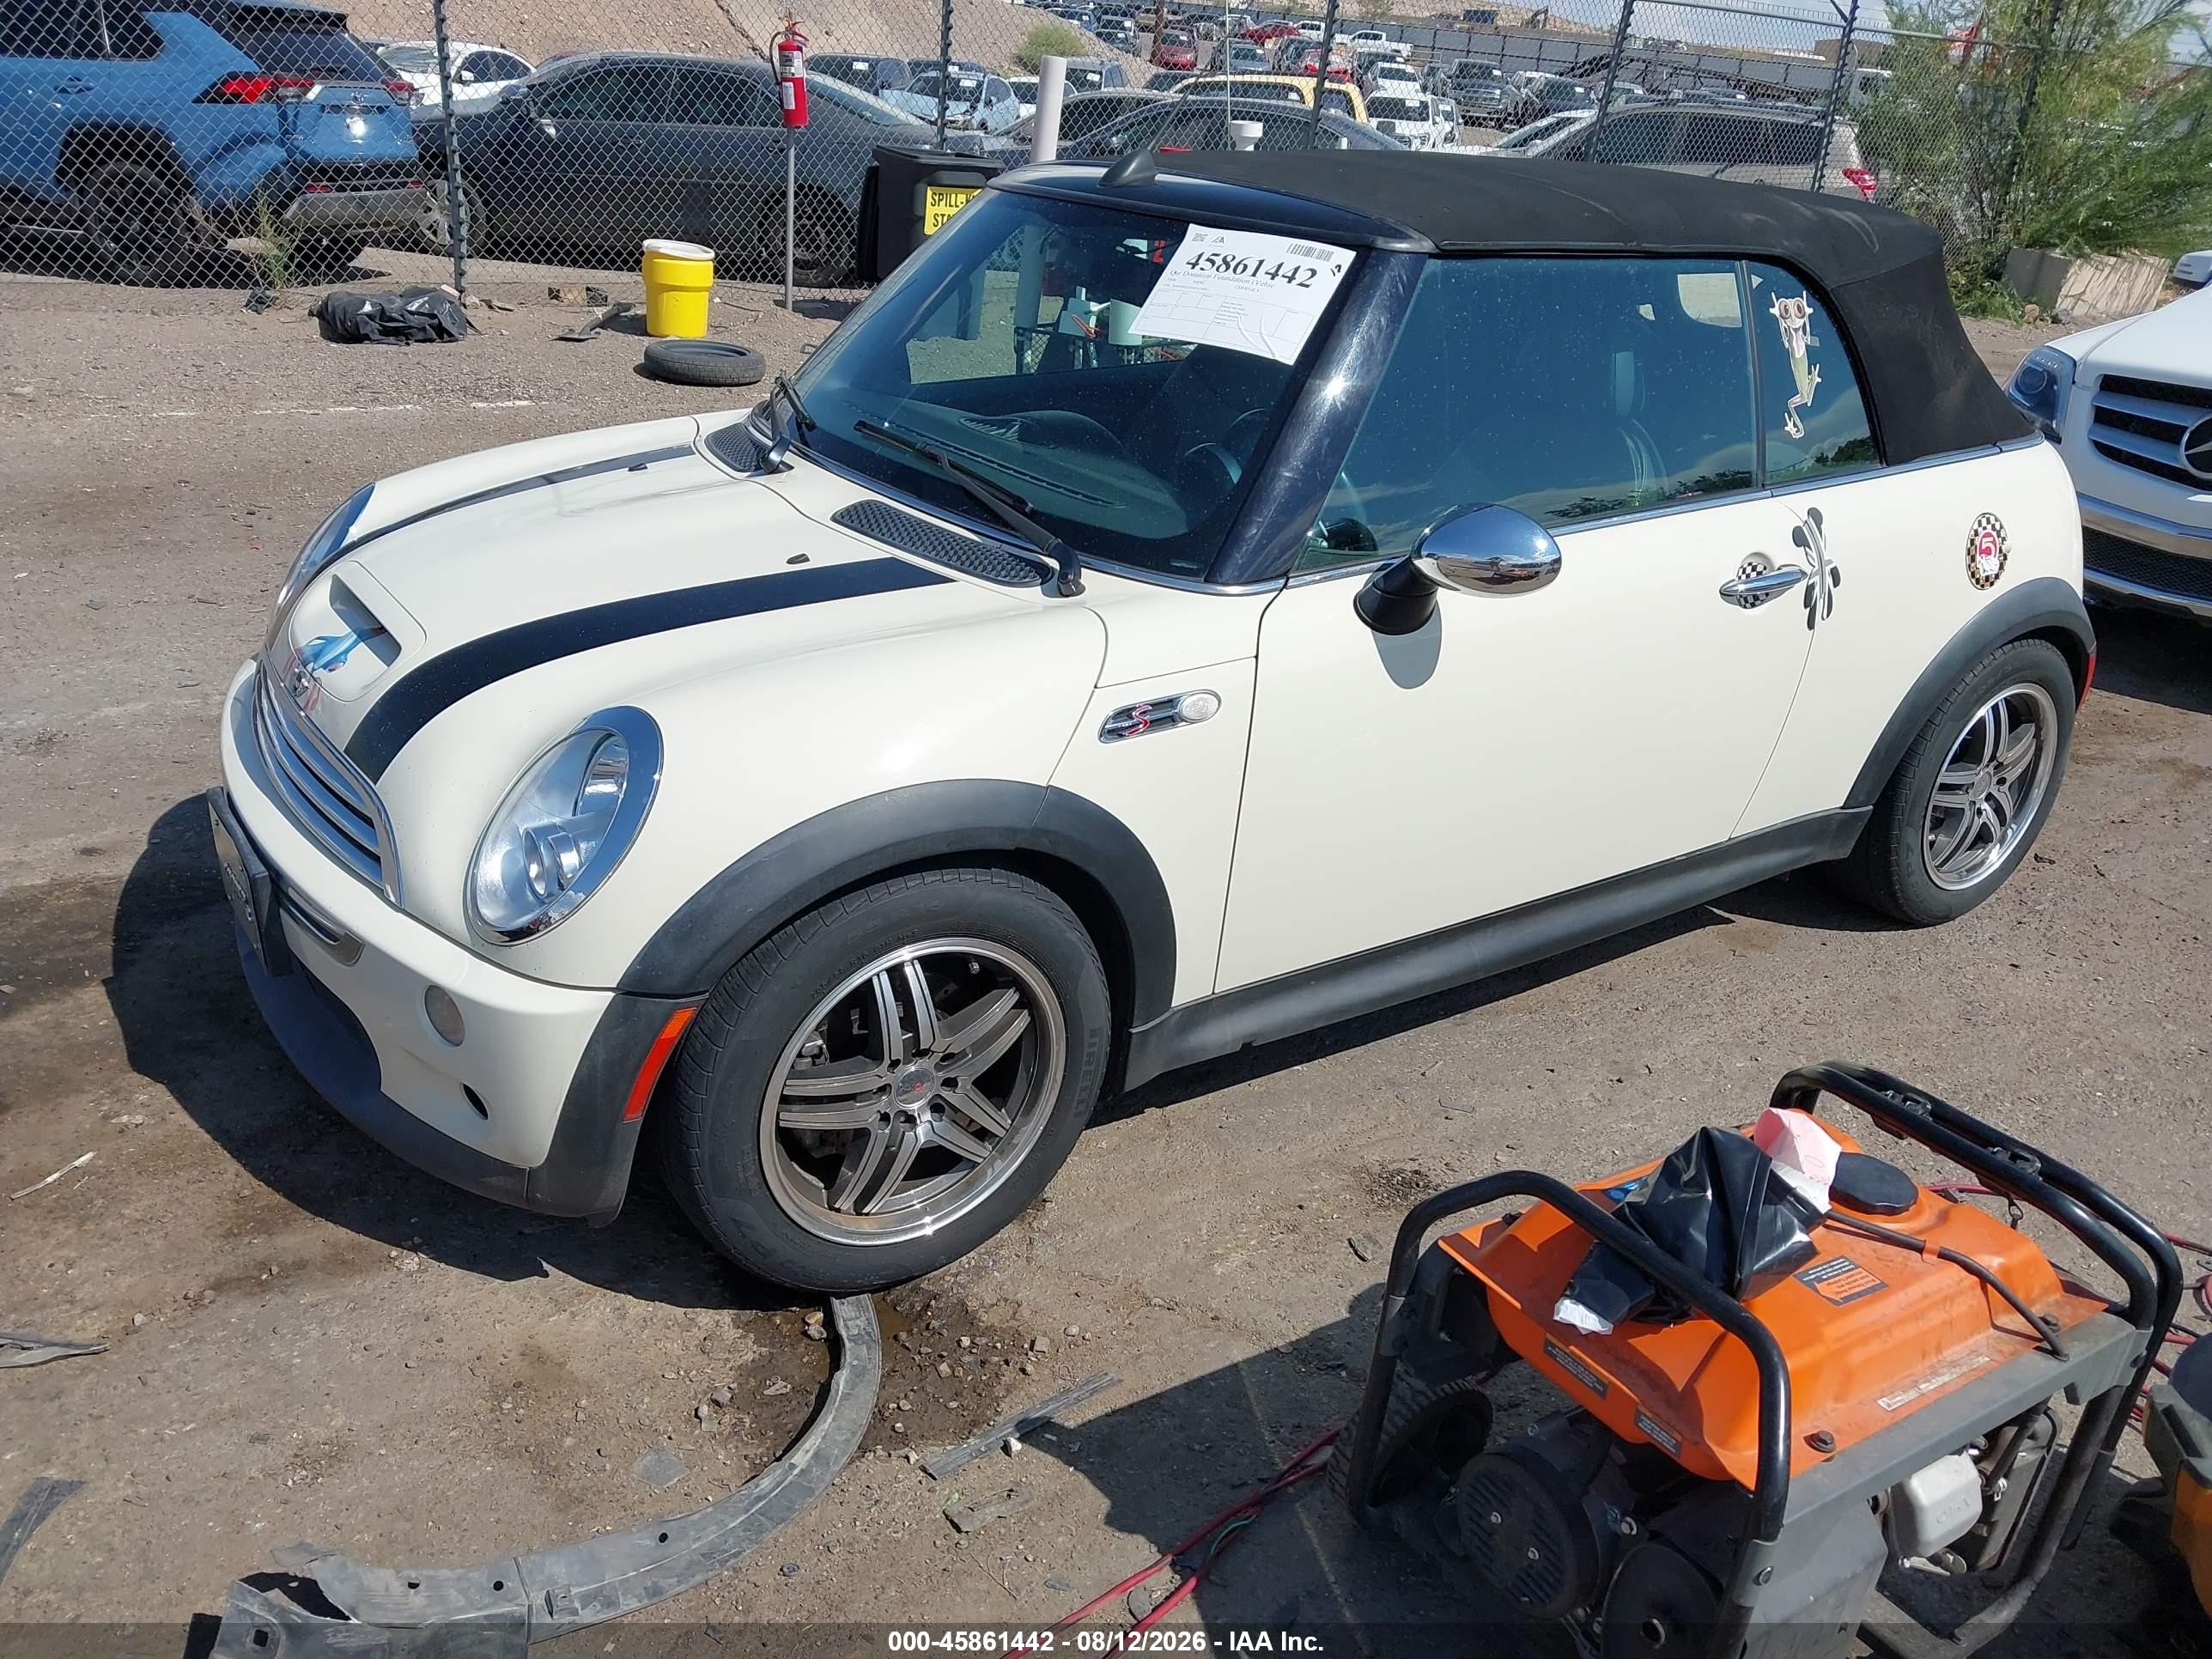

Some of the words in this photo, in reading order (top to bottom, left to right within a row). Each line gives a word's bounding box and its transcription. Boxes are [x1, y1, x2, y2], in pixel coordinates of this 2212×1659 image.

[931, 191, 976, 208] SPILL-K
[1182, 270, 1212, 279] Donation
[1213, 274, 1250, 284] Foundation
[1185, 252, 1318, 289] 45861442
[1126, 703, 1153, 737] S
